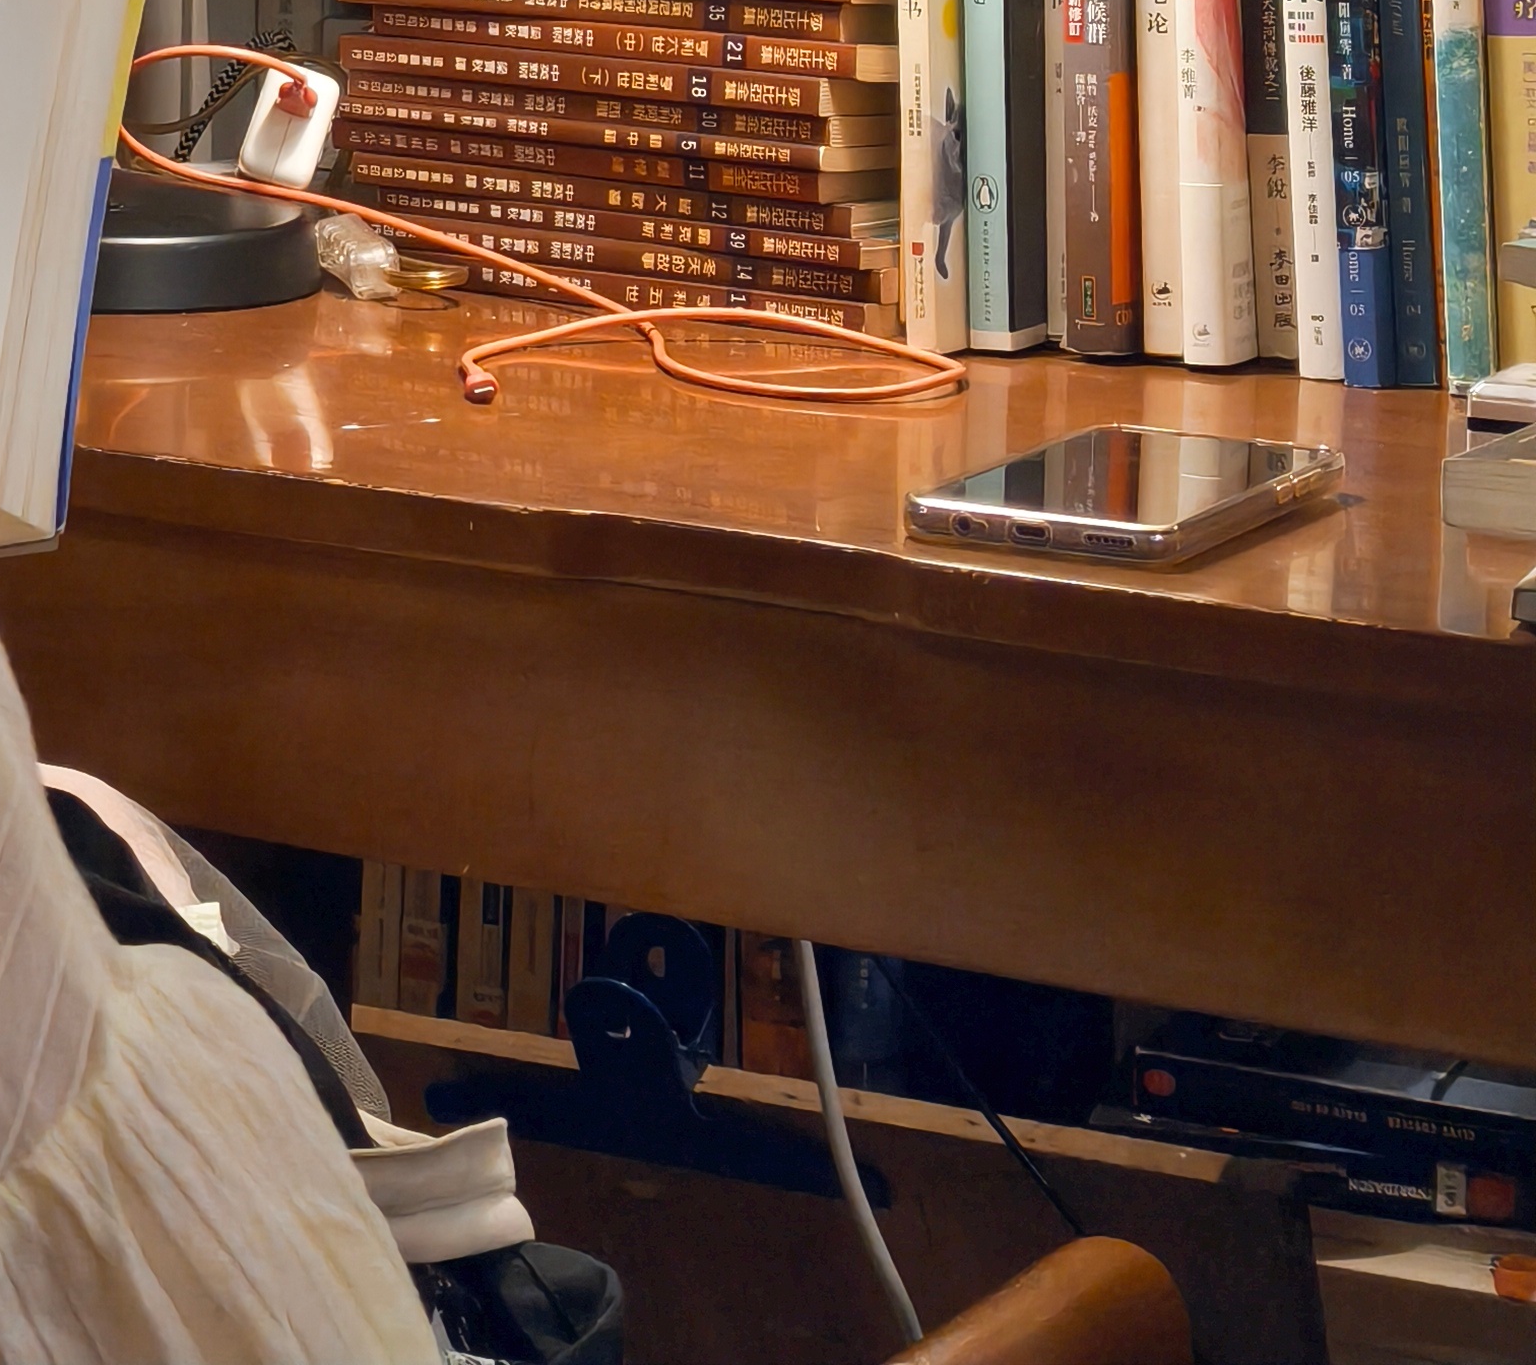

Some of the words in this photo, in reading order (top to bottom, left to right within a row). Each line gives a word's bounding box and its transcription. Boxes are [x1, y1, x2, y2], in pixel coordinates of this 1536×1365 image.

[708, 5, 725, 21] 35
[743, 6, 824, 32] 莎士比亞全集
[505, 24, 541, 39] 梁實秋
[552, 27, 593, 47] 中英對照
[726, 41, 743, 62] 21
[760, 45, 838, 71] 莎士比亞全集
[472, 59, 507, 75] 梁實秋
[518, 61, 559, 81] 中英對照
[1180, 48, 1197, 100] 李维菁
[691, 75, 707, 98] 18
[724, 80, 801, 106] 莎士比亞全集
[1298, 65, 1318, 133] 後藤雅洋
[460, 116, 496, 128] 梁實秋
[507, 119, 548, 135] 中英對照
[702, 112, 717, 128] 30
[1342, 105, 1357, 149] Home
[681, 141, 696, 150] 5
[714, 141, 790, 164] 莎士比亞全集
[689, 164, 704, 179] 11
[1343, 170, 1360, 183] 05
[482, 177, 520, 193] 梁實秋
[532, 181, 574, 201] 中英對照
[507, 207, 542, 223] 梁實秋
[711, 202, 726, 219] 12
[746, 204, 824, 230] 莎士比亞全集
[554, 211, 596, 231] 中英對照
[500, 238, 539, 254] 梁實秋
[730, 232, 746, 249] 39
[763, 237, 839, 262] 莎士比亞全集
[550, 241, 595, 262] 中英對照
[642, 252, 716, 277] 冬天的故事
[737, 264, 752, 280] 14
[1348, 246, 1360, 282] ome
[771, 266, 852, 294] 莎士比亞全集
[1269, 247, 1296, 330] 麥田出版
[1349, 304, 1366, 316] 05
